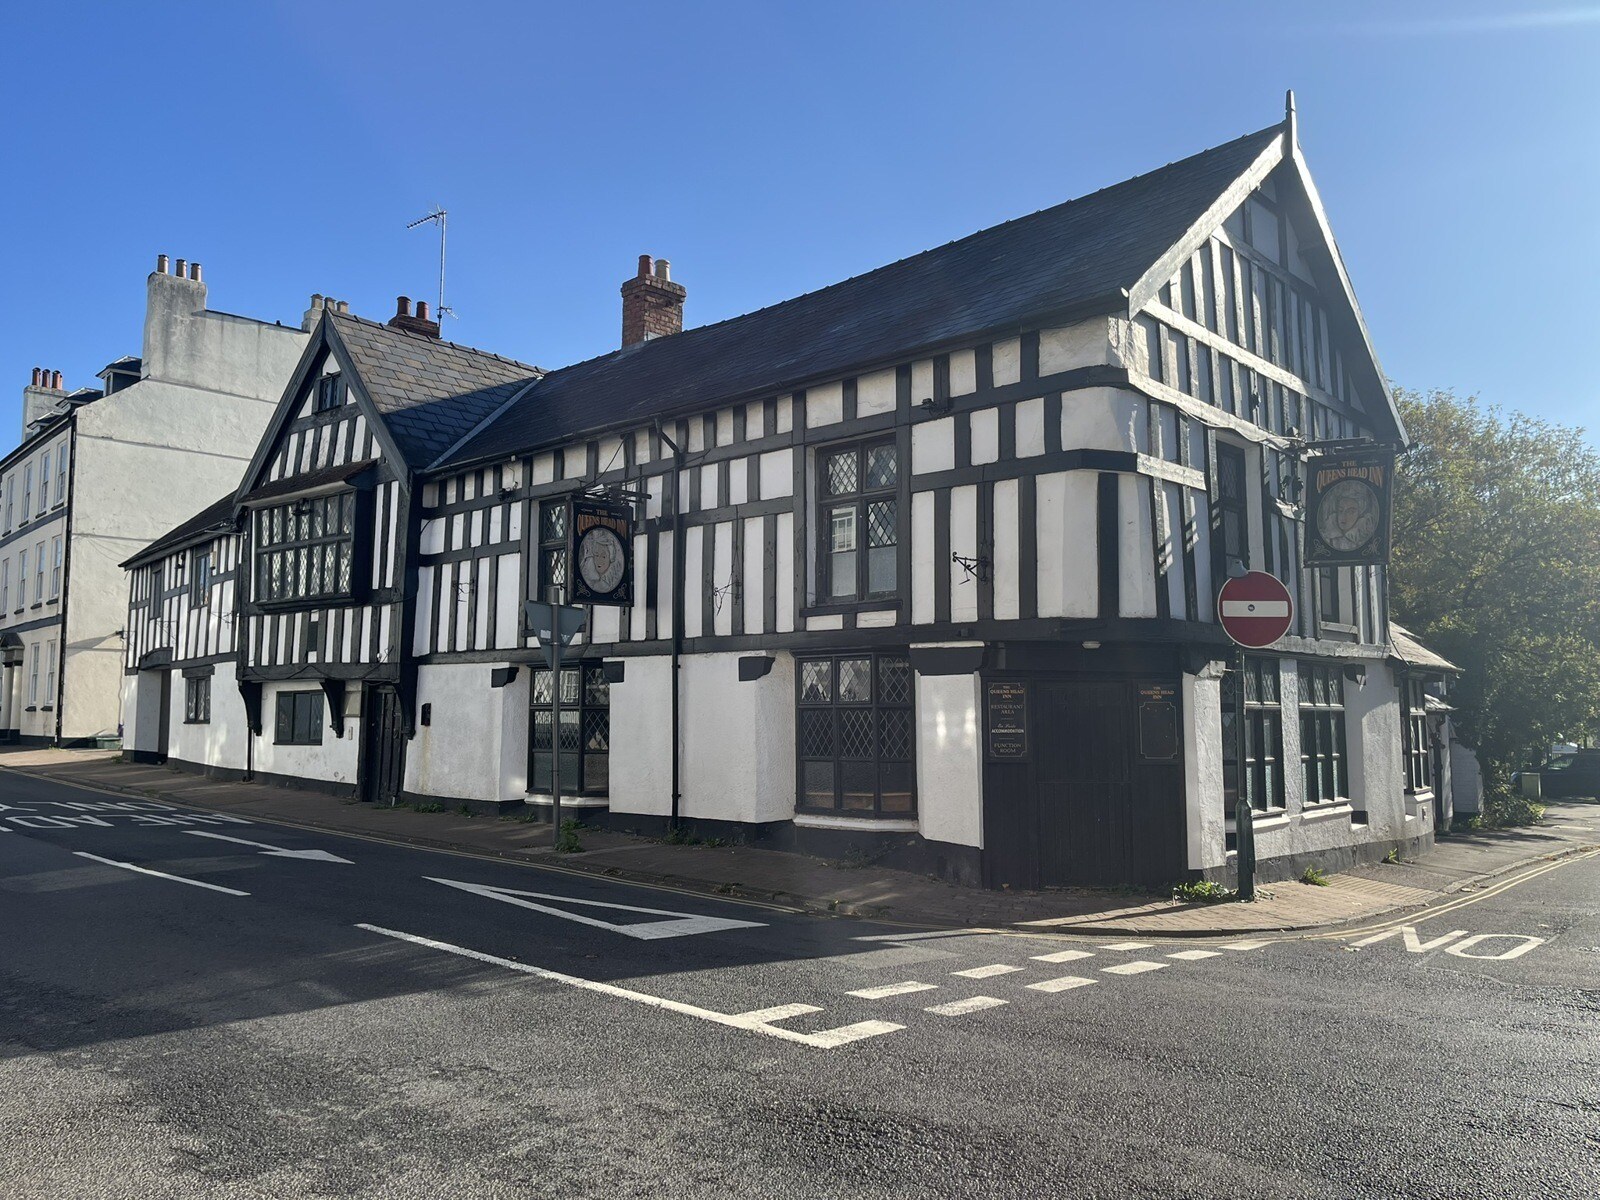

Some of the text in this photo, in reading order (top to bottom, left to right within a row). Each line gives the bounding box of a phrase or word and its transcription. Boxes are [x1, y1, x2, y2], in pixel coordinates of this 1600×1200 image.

[1316, 466, 1384, 493] QUEENS HEAD INN
[577, 514, 628, 540] QUEENS HEAD INN
[1350, 925, 1546, 960] NO
